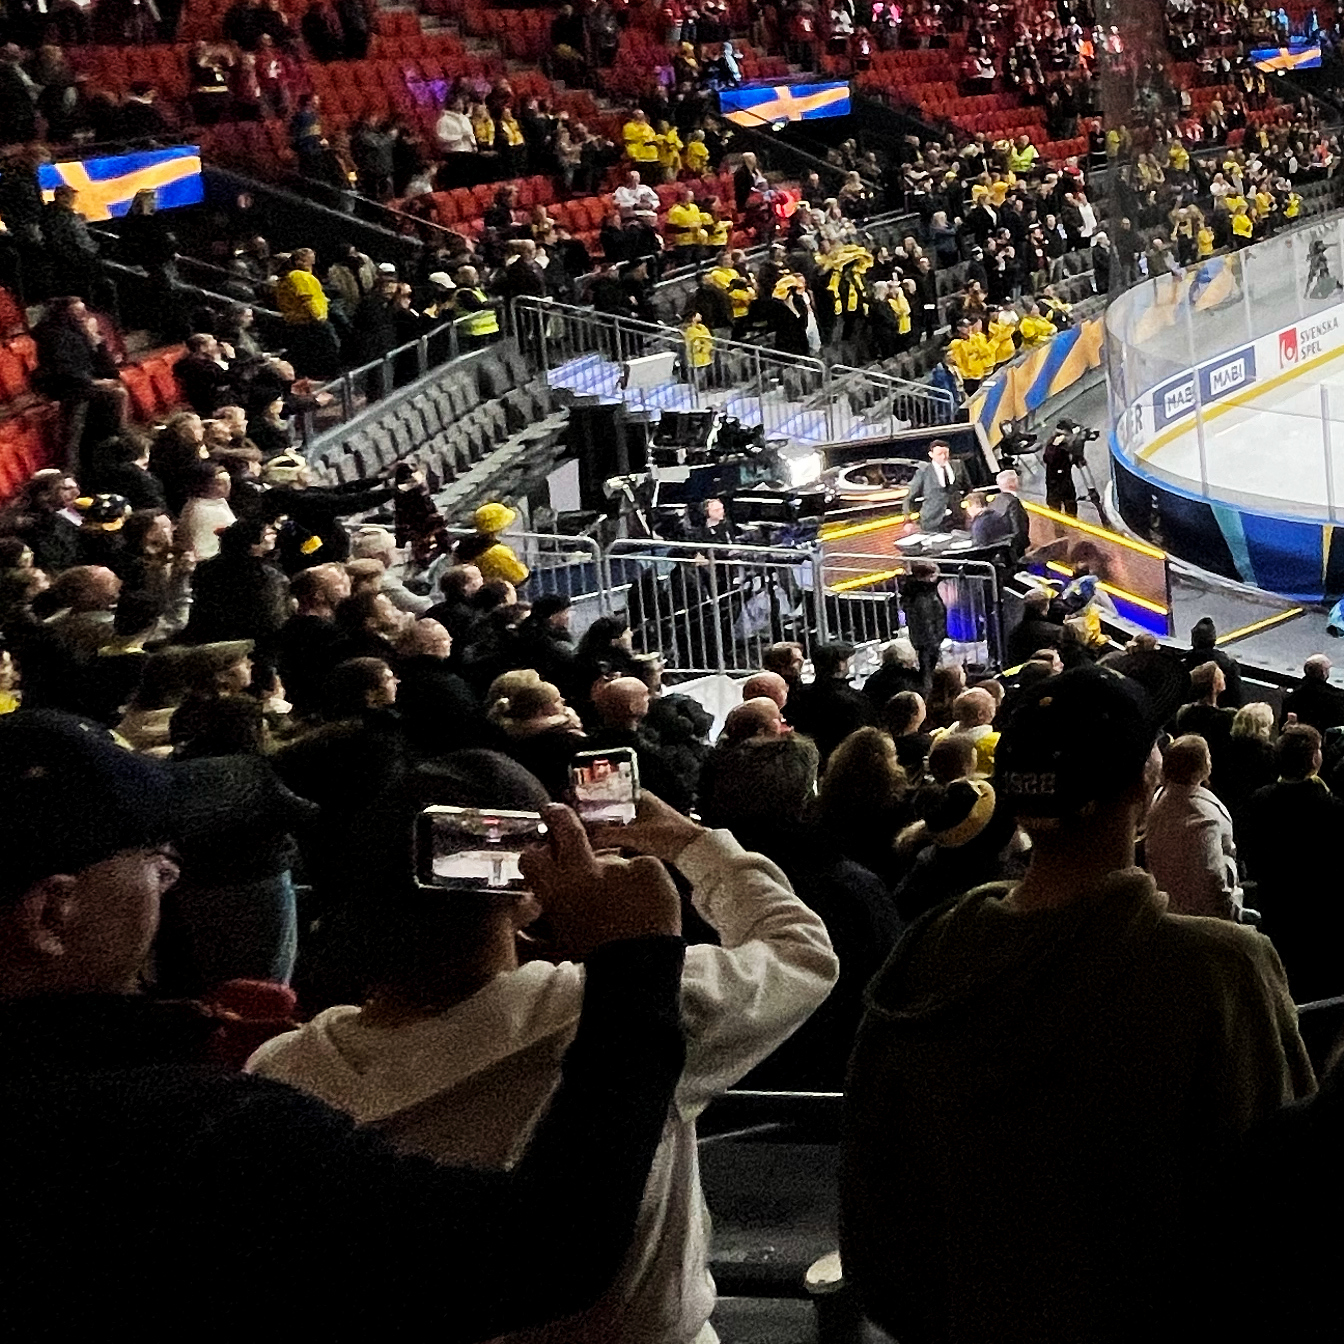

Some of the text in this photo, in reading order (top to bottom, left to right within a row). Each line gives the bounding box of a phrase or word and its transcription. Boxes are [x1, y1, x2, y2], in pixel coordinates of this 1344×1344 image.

[1300, 317, 1338, 344] SVENSKA
[1301, 341, 1323, 359] SPEL
[1213, 364, 1243, 389] MABI
[1166, 385, 1195, 412] MAB
